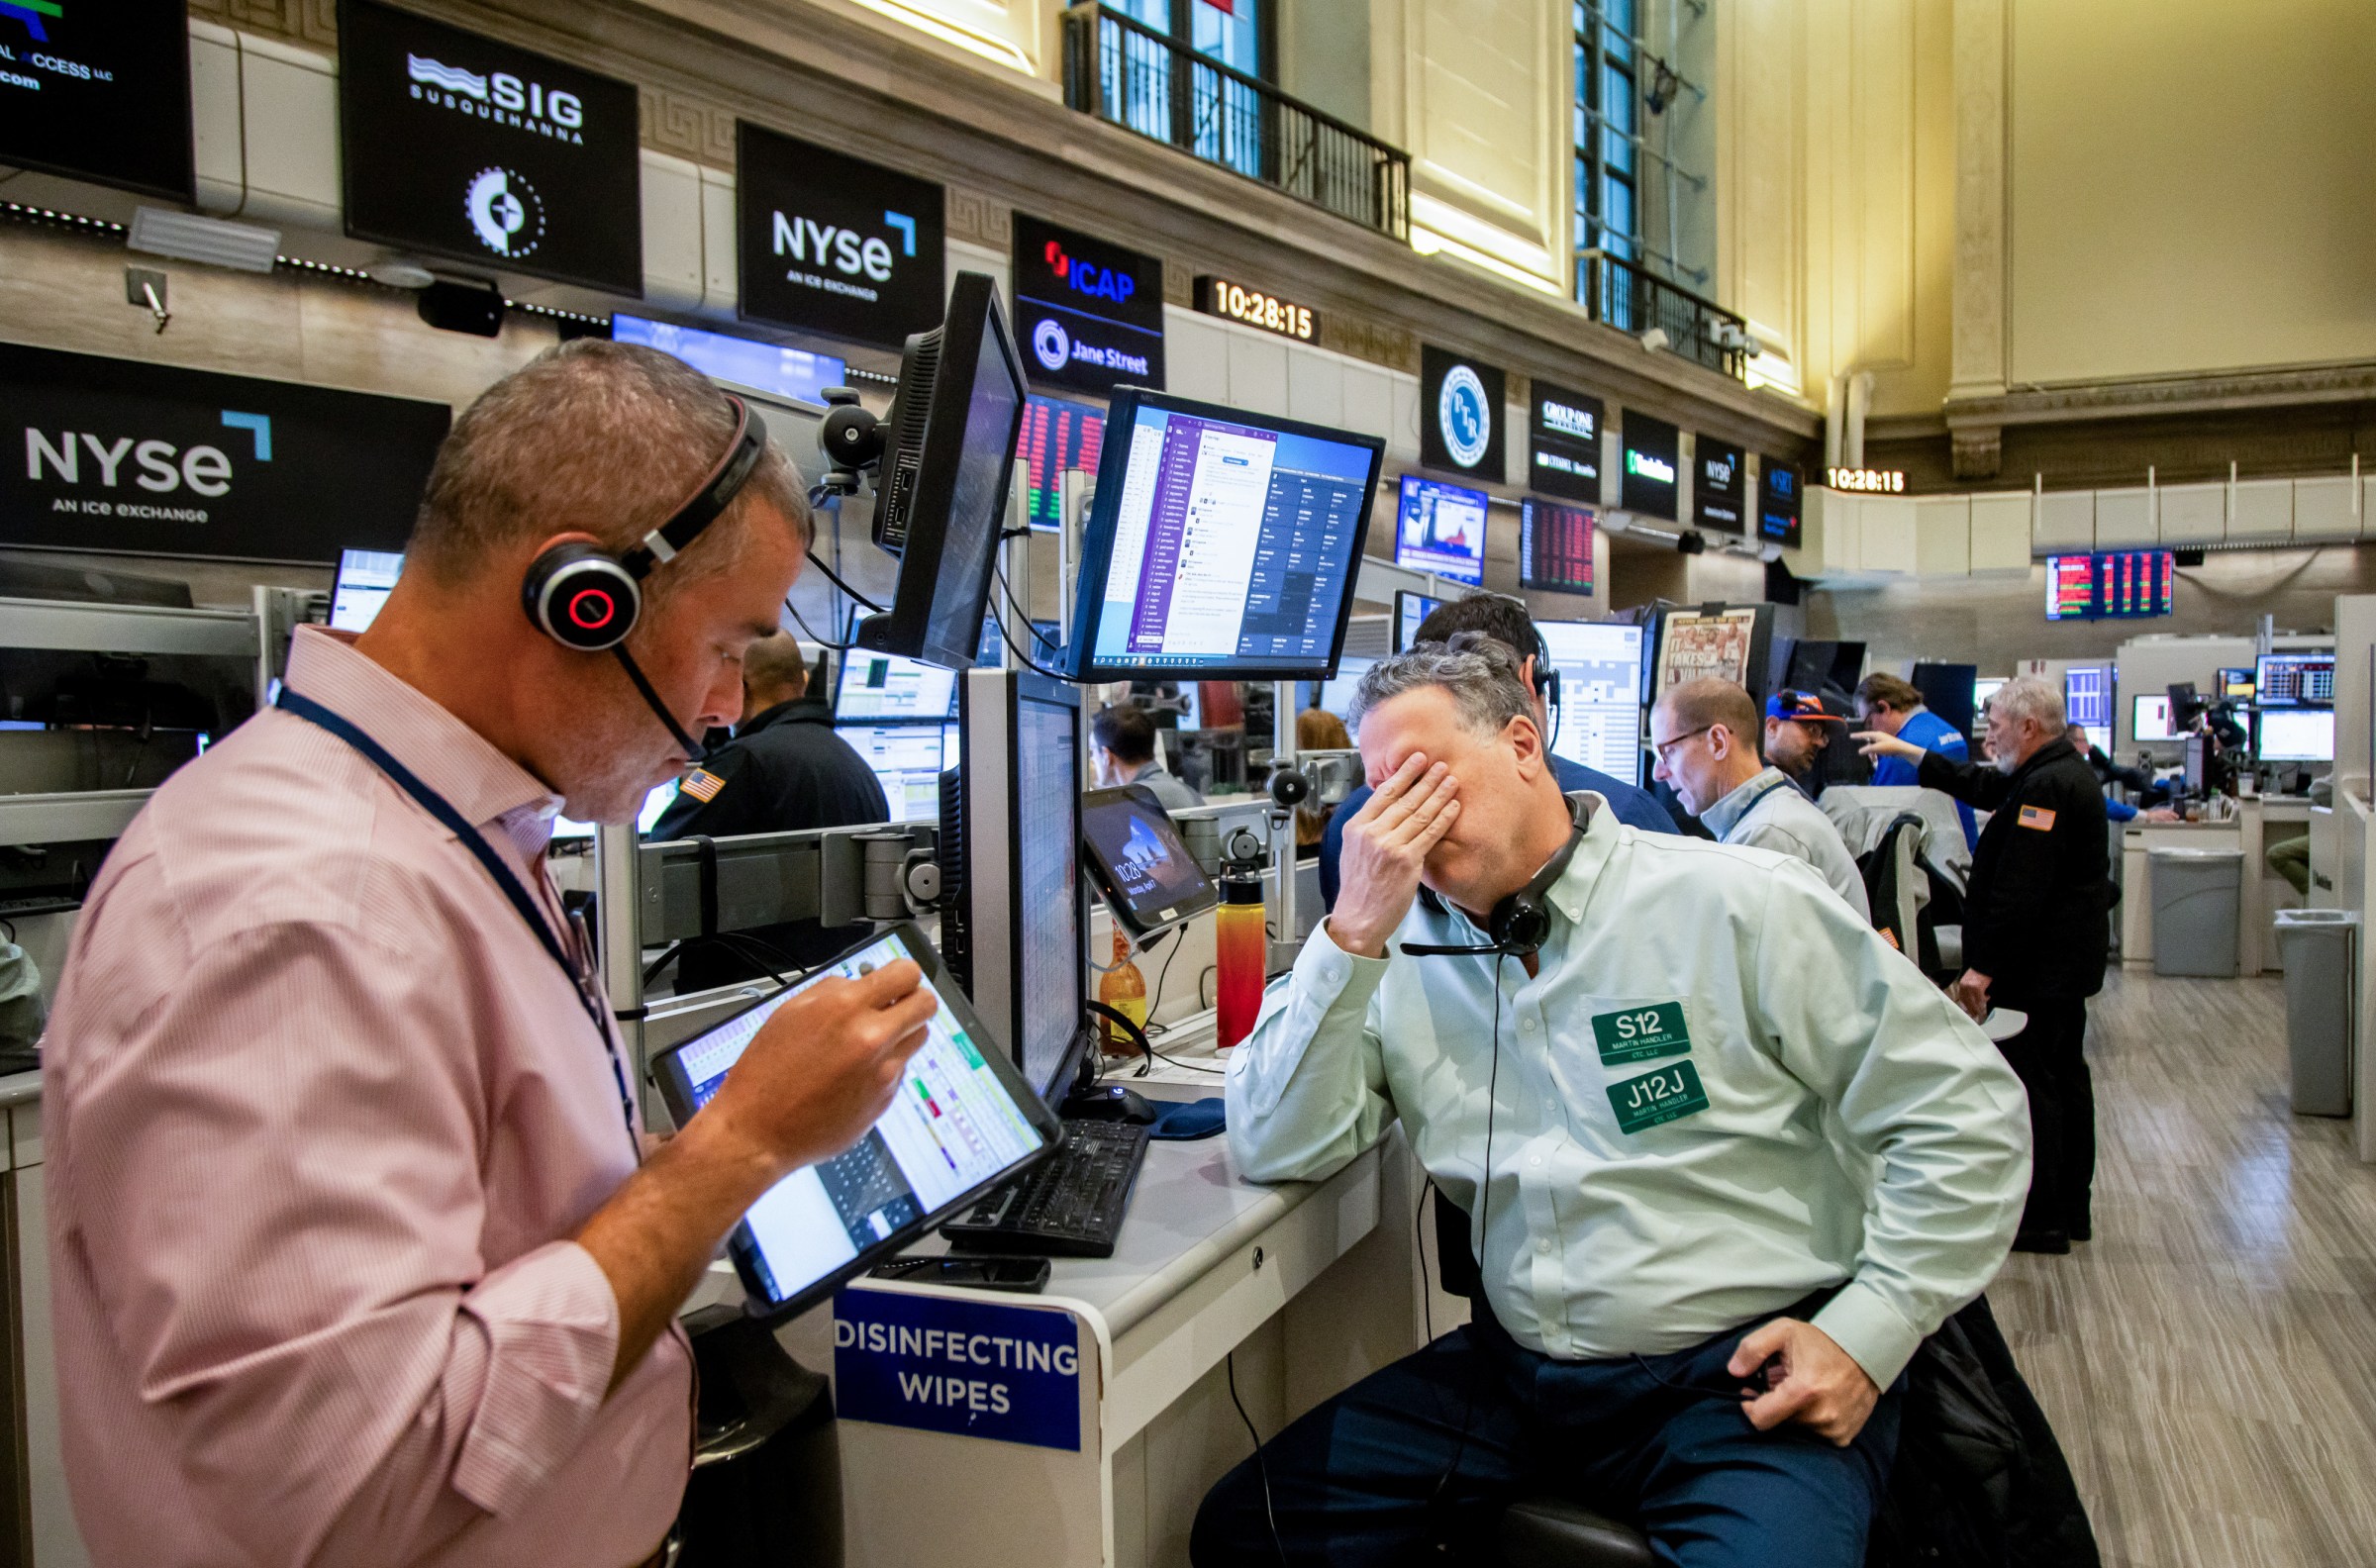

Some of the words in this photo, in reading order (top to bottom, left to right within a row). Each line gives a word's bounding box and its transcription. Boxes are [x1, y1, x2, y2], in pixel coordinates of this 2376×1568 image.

[20, 51, 91, 80] ACCESS
[93, 67, 114, 81] LLC
[409, 83, 584, 147] SUSQUEHANNA
[491, 72, 583, 129] SIG
[1070, 258, 1136, 303] ICAP
[1215, 281, 1313, 339] 10:28:15
[1071, 340, 1106, 365] Jane
[1105, 347, 1148, 376] Street
[1828, 467, 1905, 492] 10:28:15
[52, 498, 78, 513] AN
[1115, 861, 1141, 882] 10:28
[1612, 1039, 1640, 1050] MARTIN
[1639, 1032, 1673, 1045] HANDLER
[1616, 1011, 1663, 1038] S12
[1628, 1069, 1685, 1109] J12J
[1634, 1104, 1657, 1118] MARTIN
[1658, 1093, 1689, 1110] HANDLER
[834, 1319, 1079, 1377] DISINFECTING
[898, 1371, 1011, 1415] WIPES
